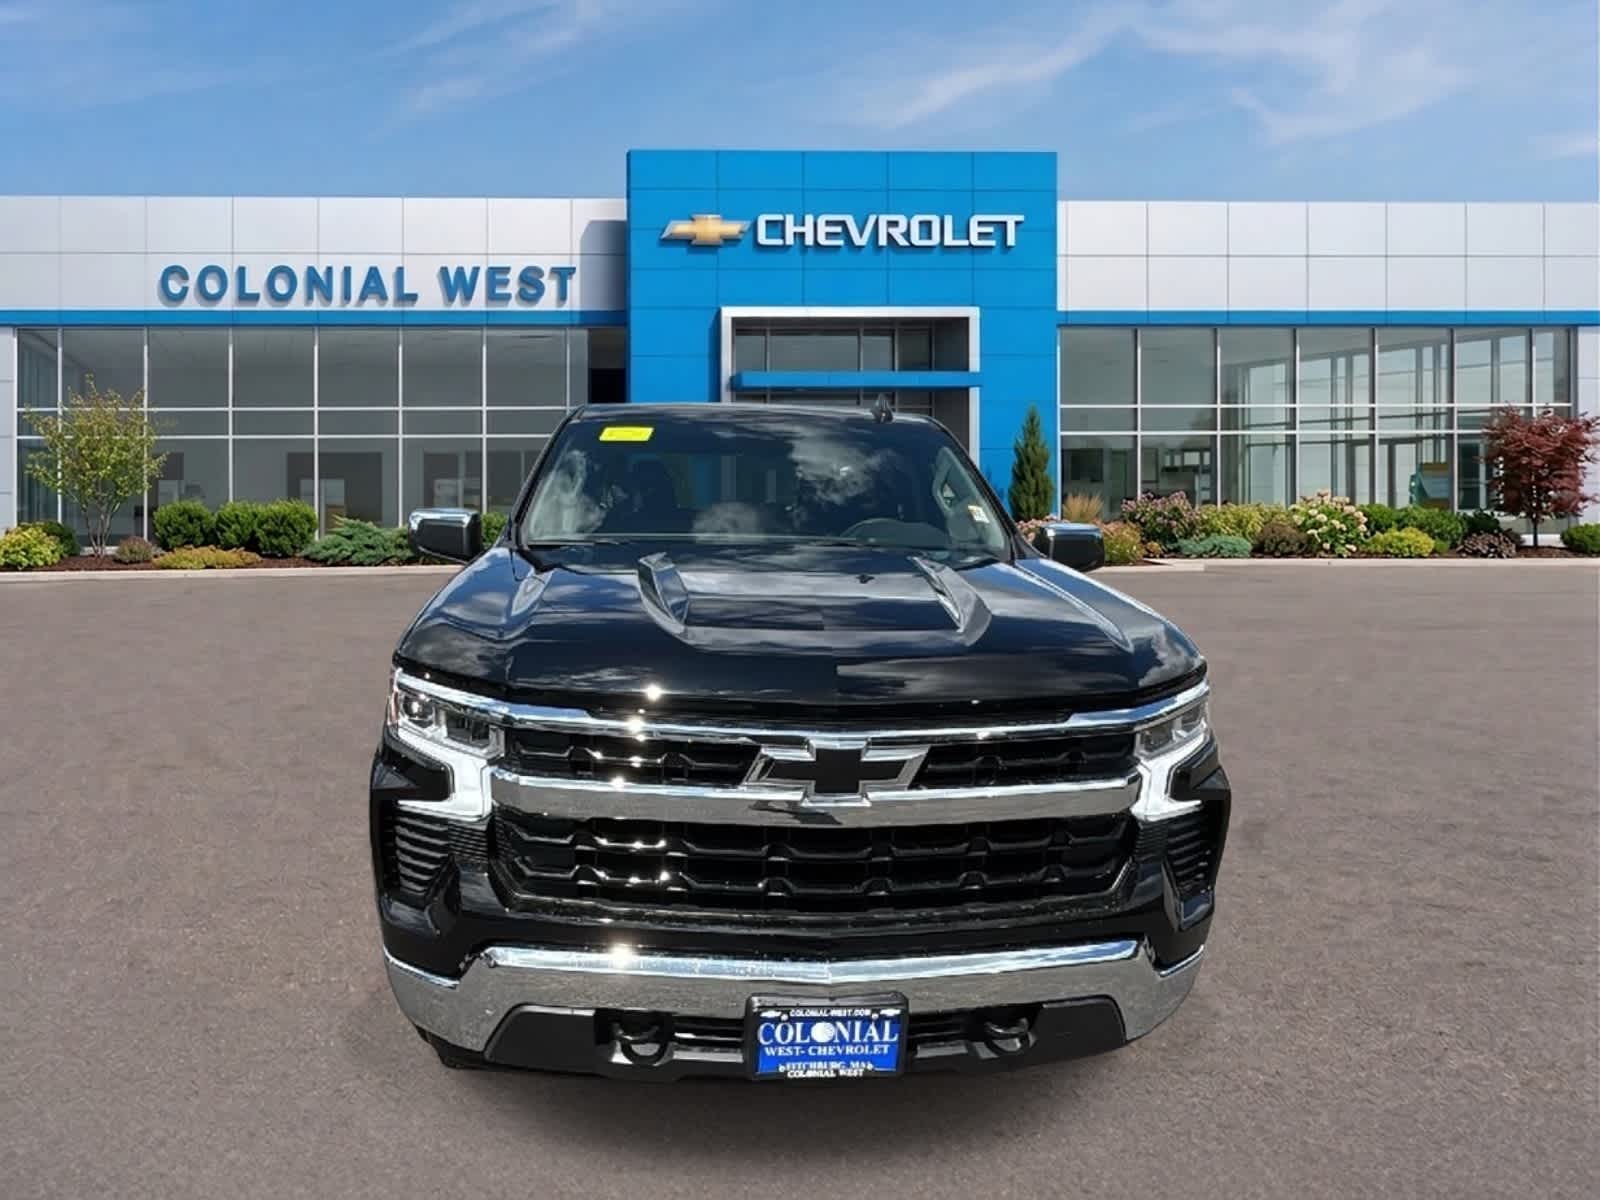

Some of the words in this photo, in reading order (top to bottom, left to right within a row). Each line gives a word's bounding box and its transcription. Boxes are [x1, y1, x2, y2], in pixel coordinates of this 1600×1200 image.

[756, 213, 1024, 247] CHEVROLET
[159, 264, 418, 306] COLONIAL
[437, 265, 577, 307] WEST
[757, 1020, 898, 1045] COLONIAL
[808, 1044, 890, 1055] CHEVROLET
[787, 1069, 836, 1078] COLONIAL
[839, 1068, 864, 1077] WEST
